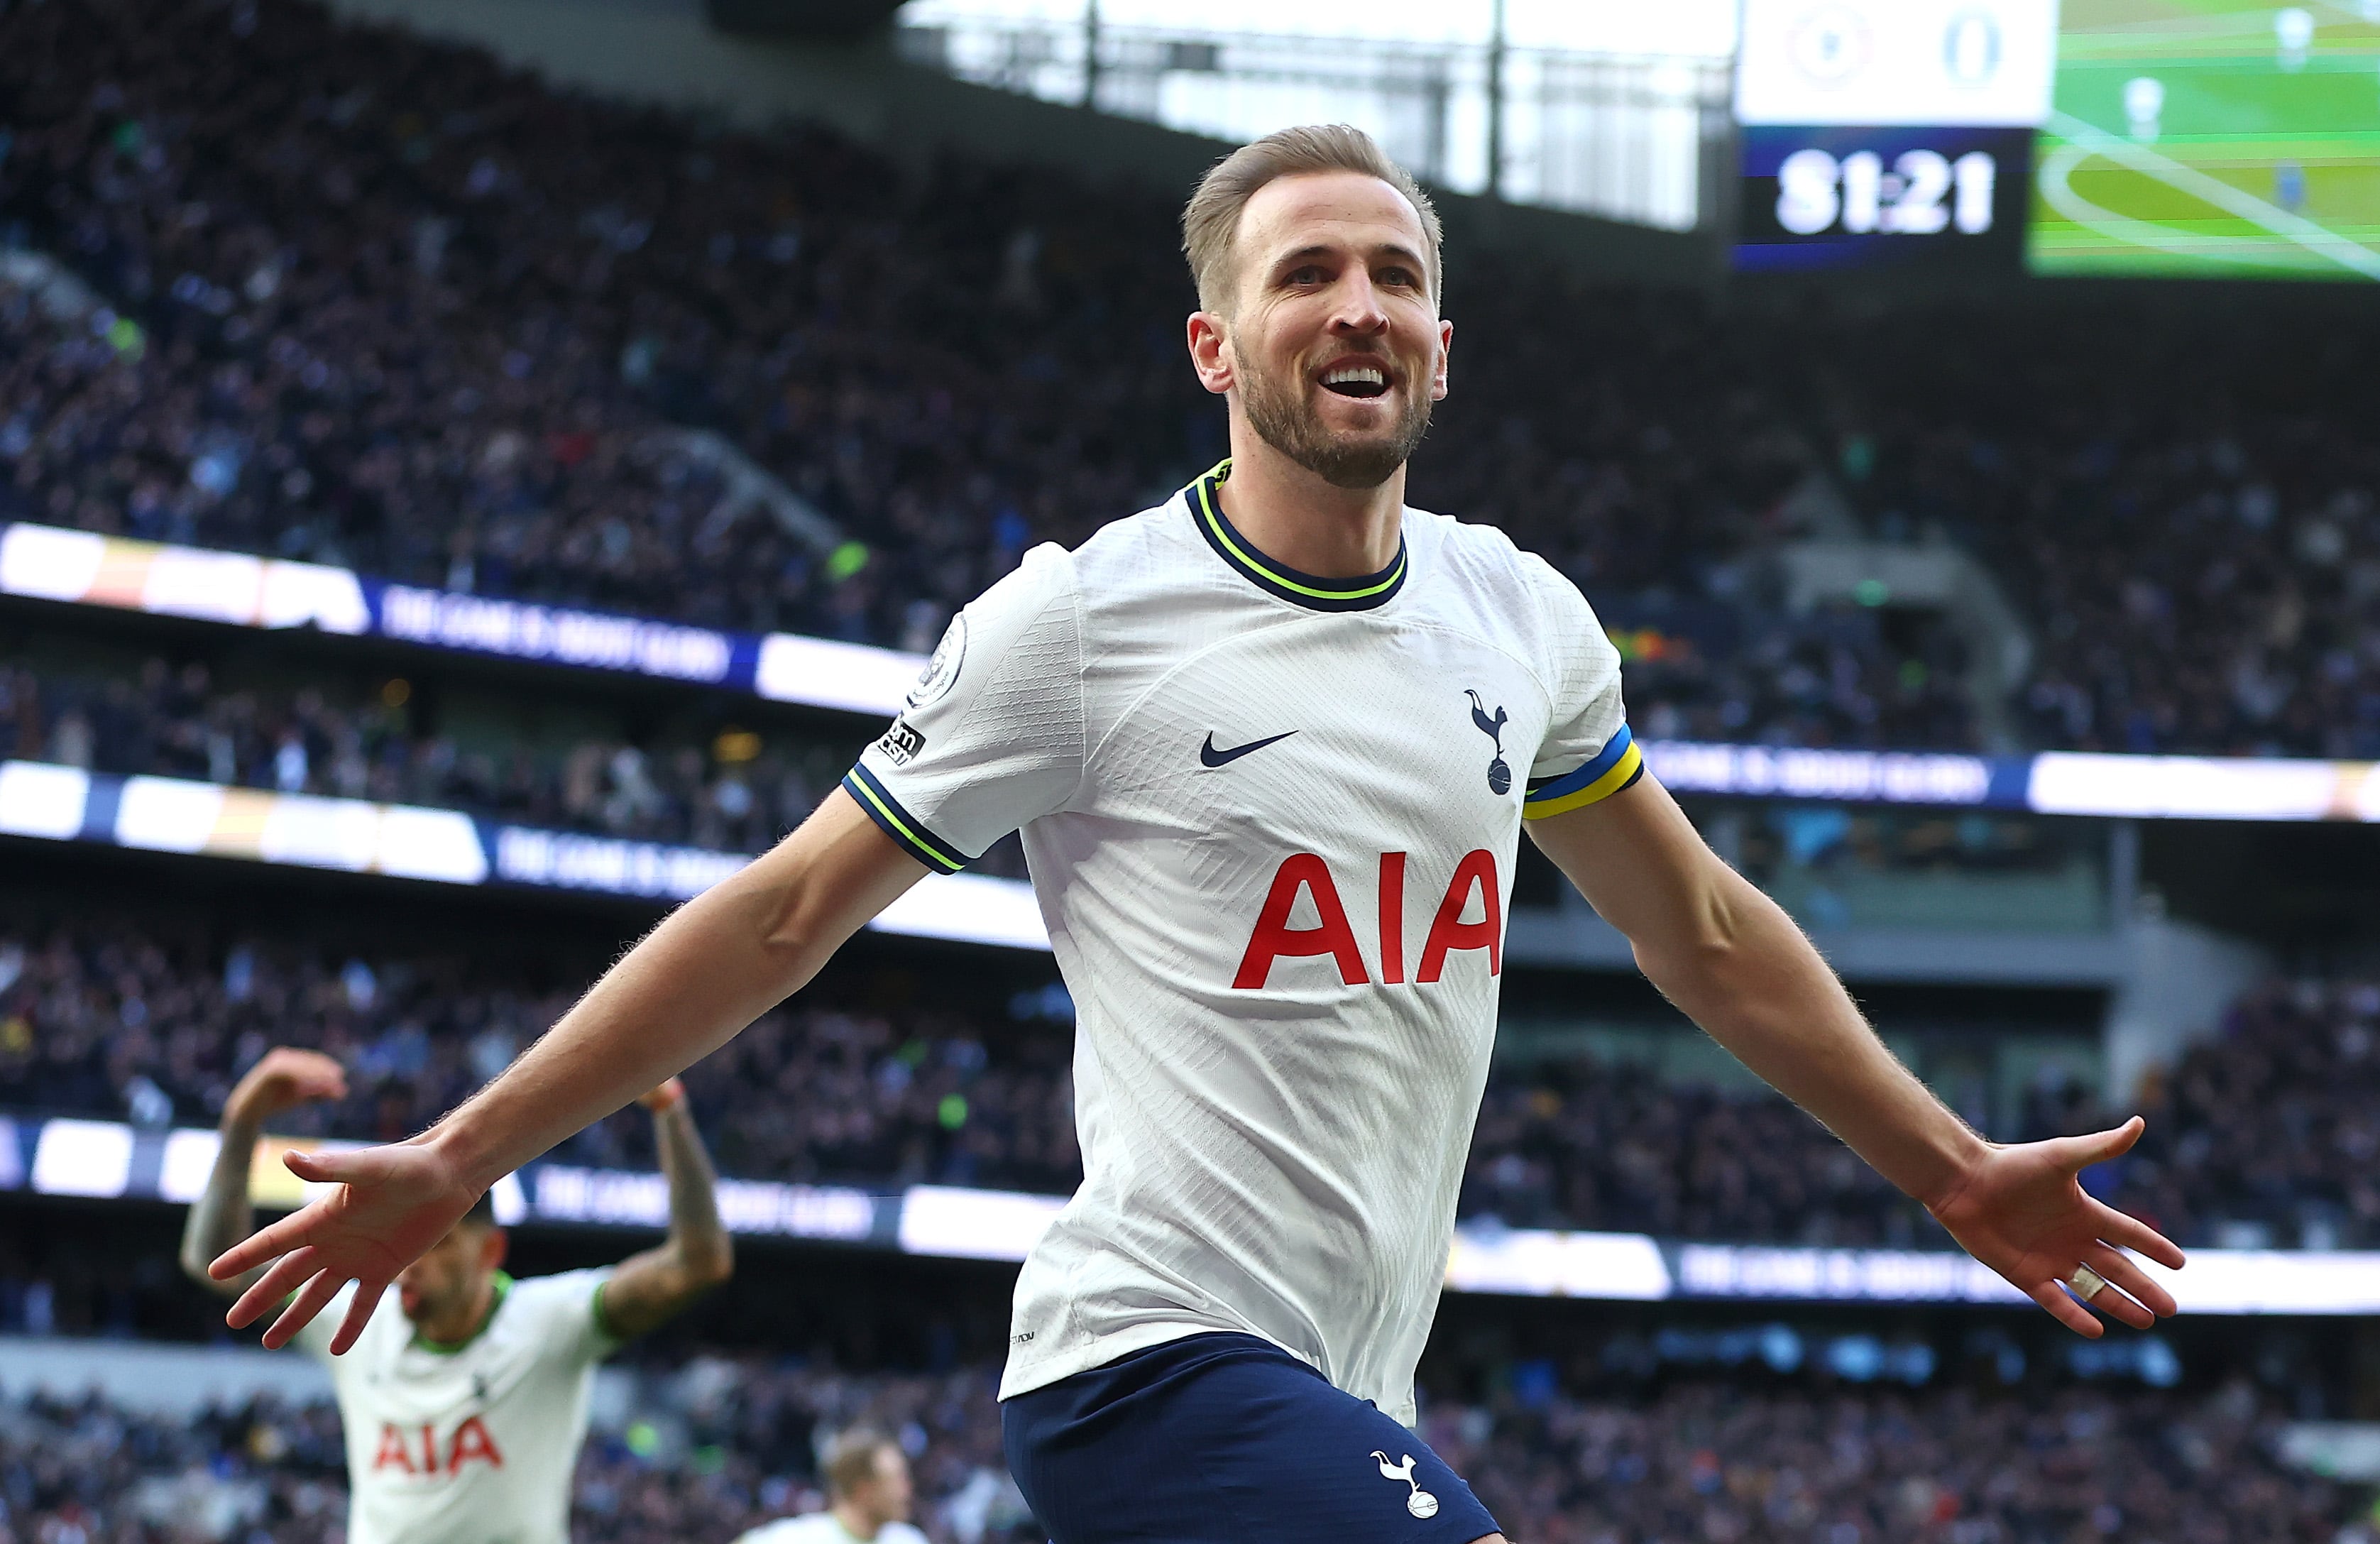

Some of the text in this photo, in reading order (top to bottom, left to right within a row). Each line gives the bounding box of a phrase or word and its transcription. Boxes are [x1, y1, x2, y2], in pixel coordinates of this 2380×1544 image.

[1777, 149, 1997, 234] 81:21
[1232, 848, 1501, 989] AIA
[373, 1416, 504, 1477] AIA
